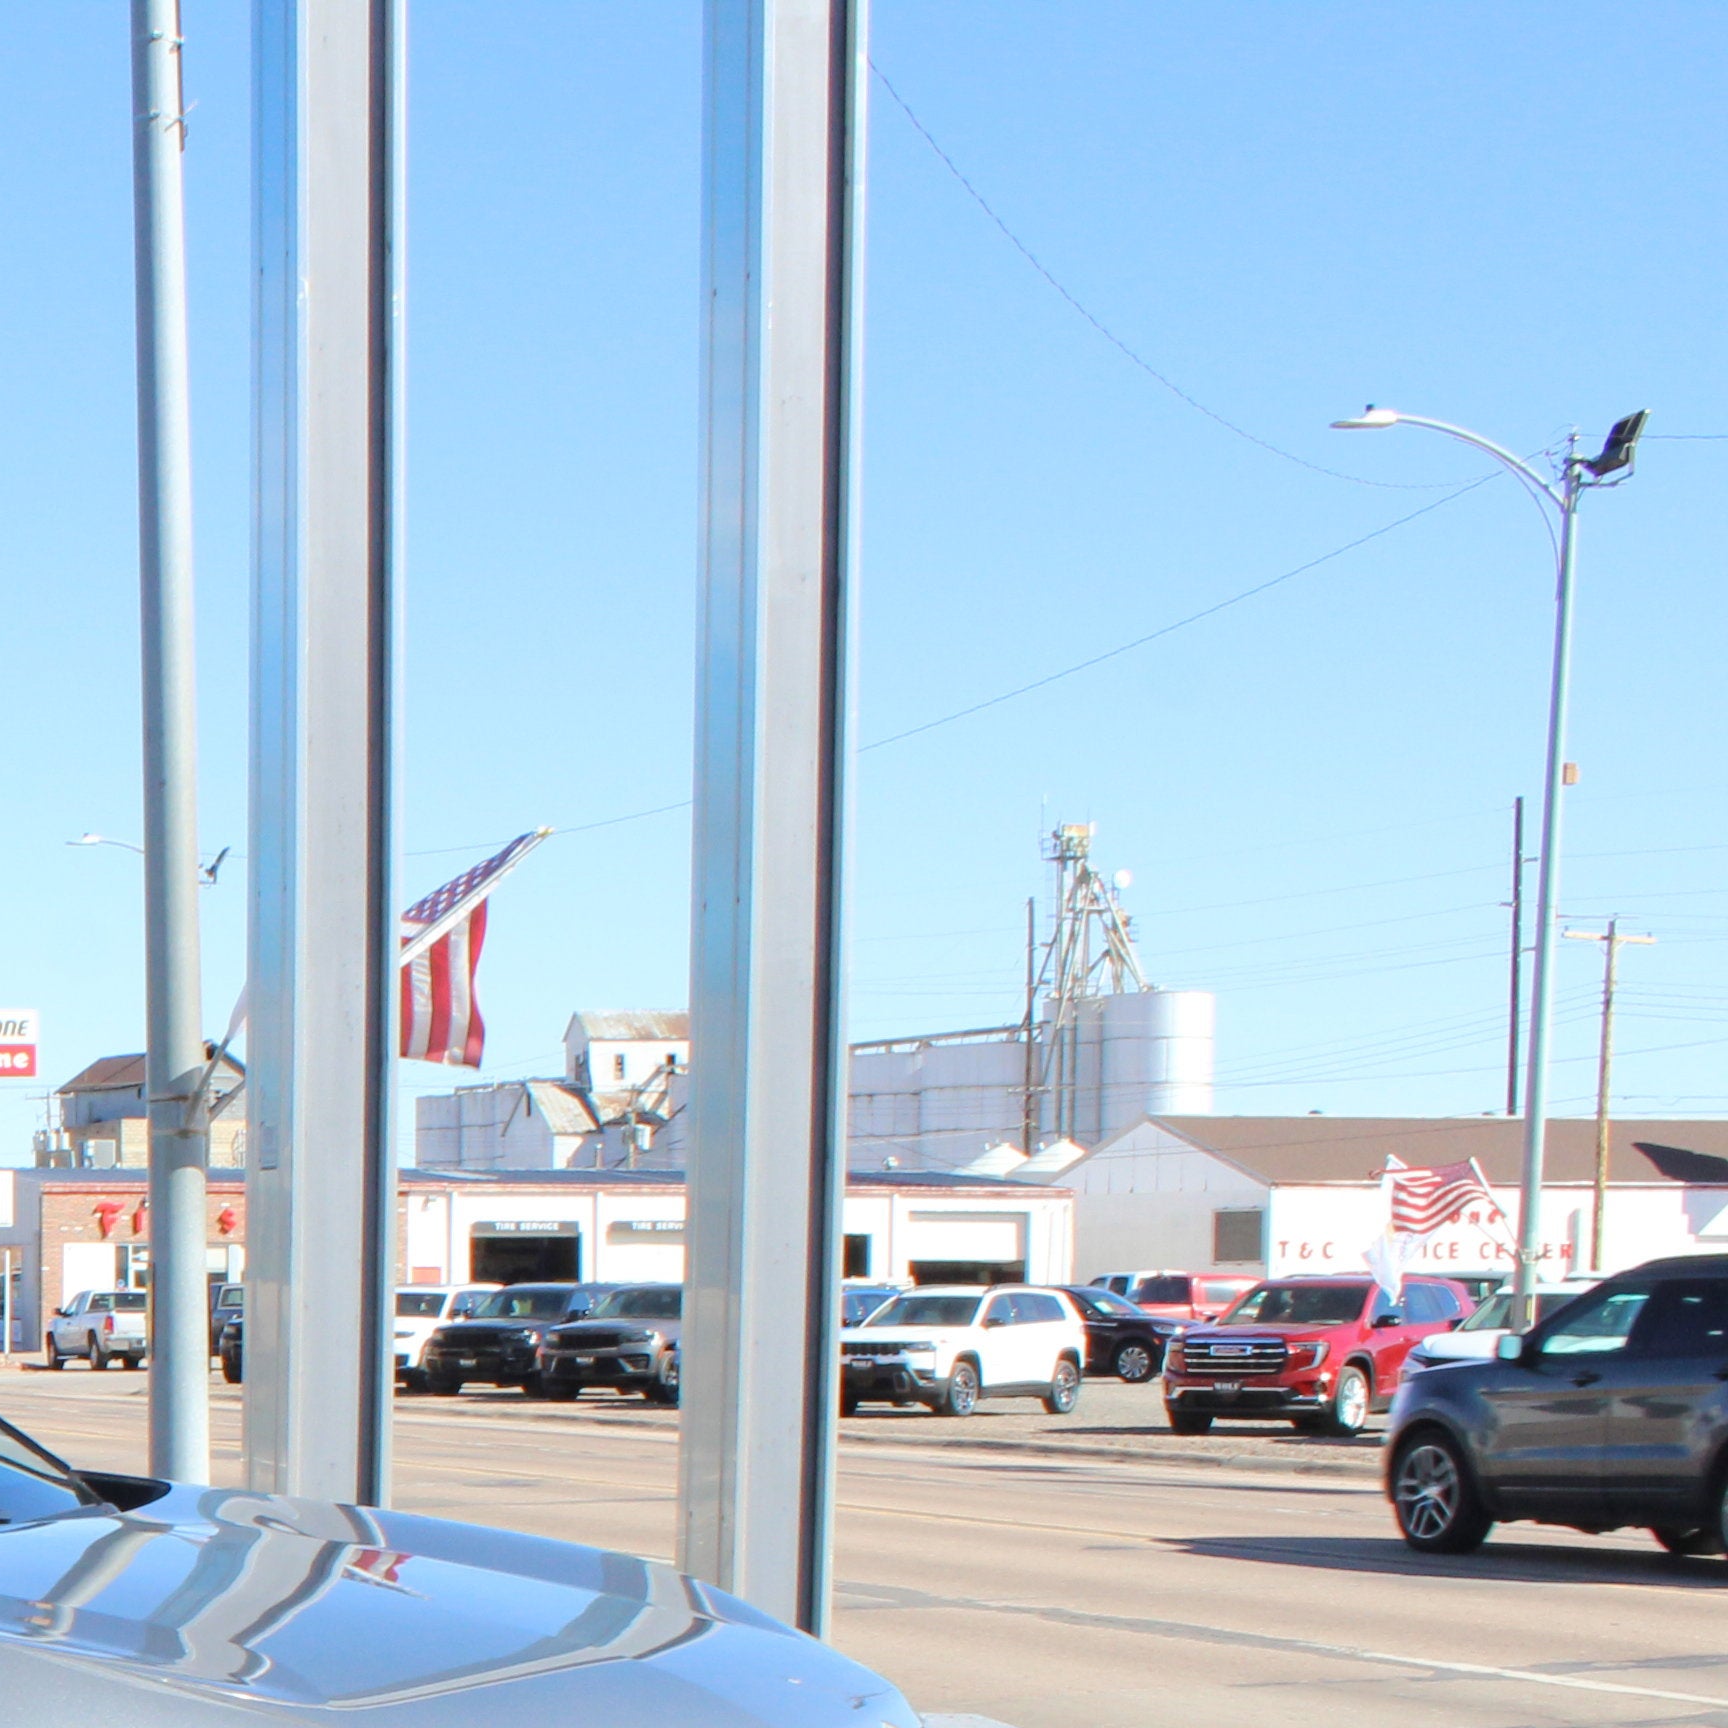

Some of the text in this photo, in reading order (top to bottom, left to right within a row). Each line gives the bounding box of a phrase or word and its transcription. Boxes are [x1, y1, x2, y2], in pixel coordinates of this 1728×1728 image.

[495, 1222, 559, 1232] TIRE SERVICE
[632, 1222, 684, 1231] TIRE SERVI
[1278, 1241, 1334, 1259] T & C
[1479, 1241, 1573, 1260] CEER
